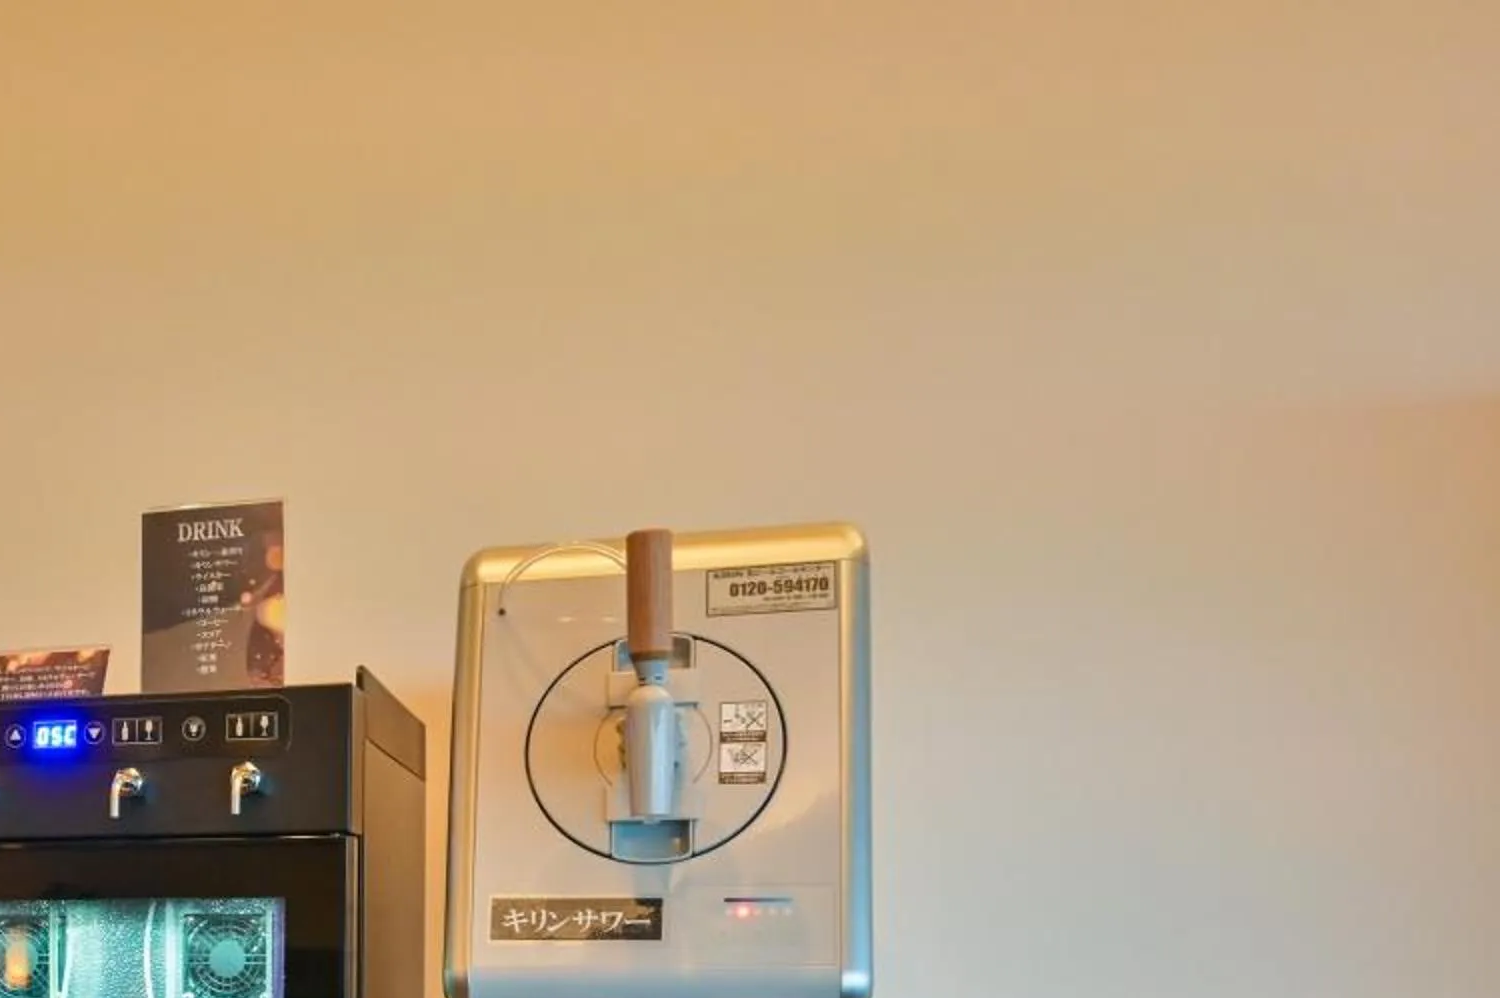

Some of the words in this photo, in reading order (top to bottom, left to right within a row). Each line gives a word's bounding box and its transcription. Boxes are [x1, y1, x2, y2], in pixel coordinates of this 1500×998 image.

[177, 517, 245, 542] DRINK
[729, 576, 830, 598] 0120-594170
[501, 908, 652, 934] キリンサワー
